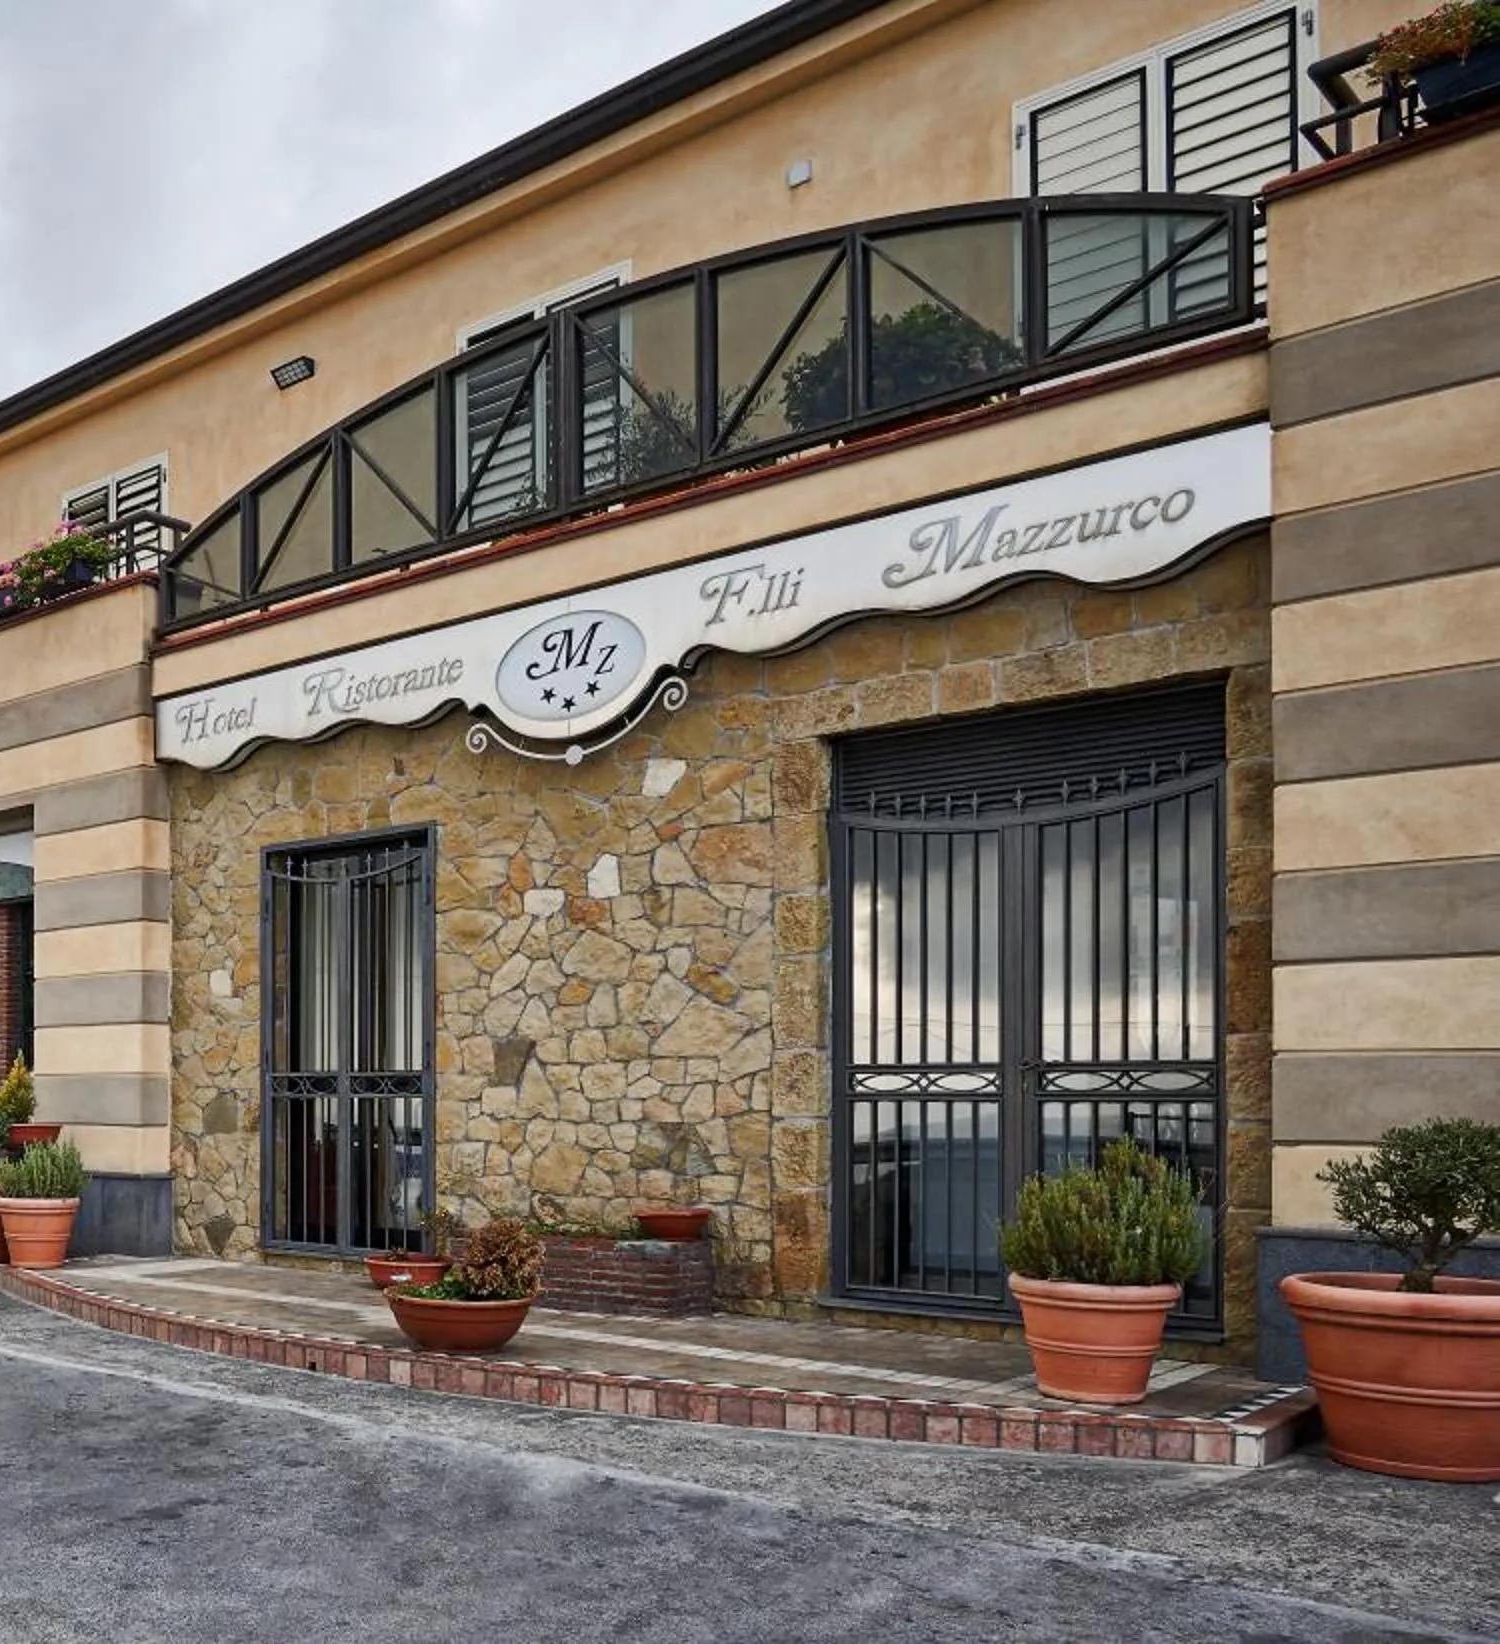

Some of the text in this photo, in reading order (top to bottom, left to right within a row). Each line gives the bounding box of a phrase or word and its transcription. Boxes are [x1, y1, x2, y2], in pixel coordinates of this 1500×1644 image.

[699, 488, 1196, 627] F.lli Mazzurco
[174, 657, 464, 744] Hotel Ristorante
